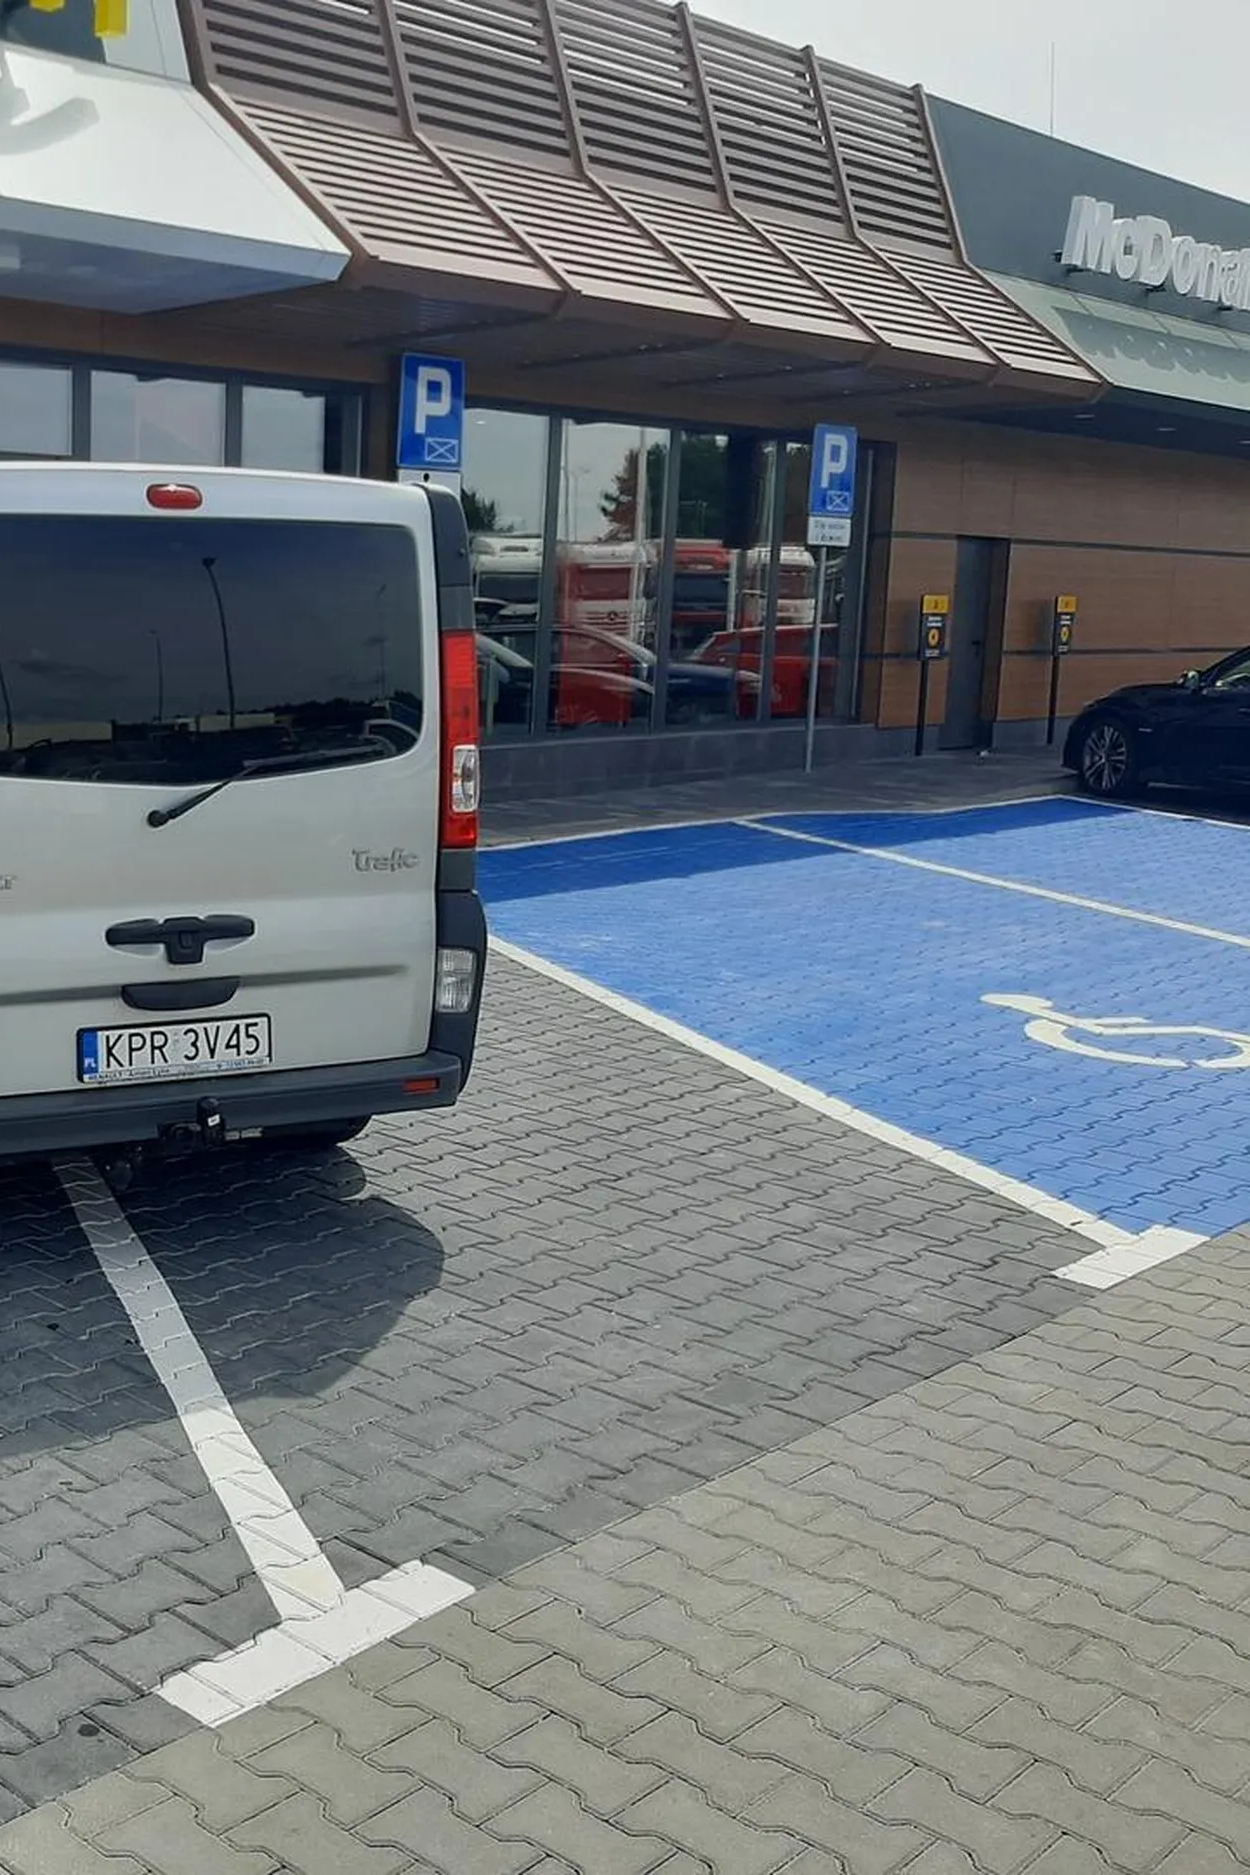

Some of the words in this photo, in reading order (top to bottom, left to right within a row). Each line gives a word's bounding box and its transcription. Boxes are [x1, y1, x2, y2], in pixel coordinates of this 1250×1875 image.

[414, 365, 451, 434] P
[820, 433, 848, 488] P
[85, 1058, 96, 1068] PL
[105, 1030, 168, 1069] KPR
[183, 1022, 261, 1061] 3V45
